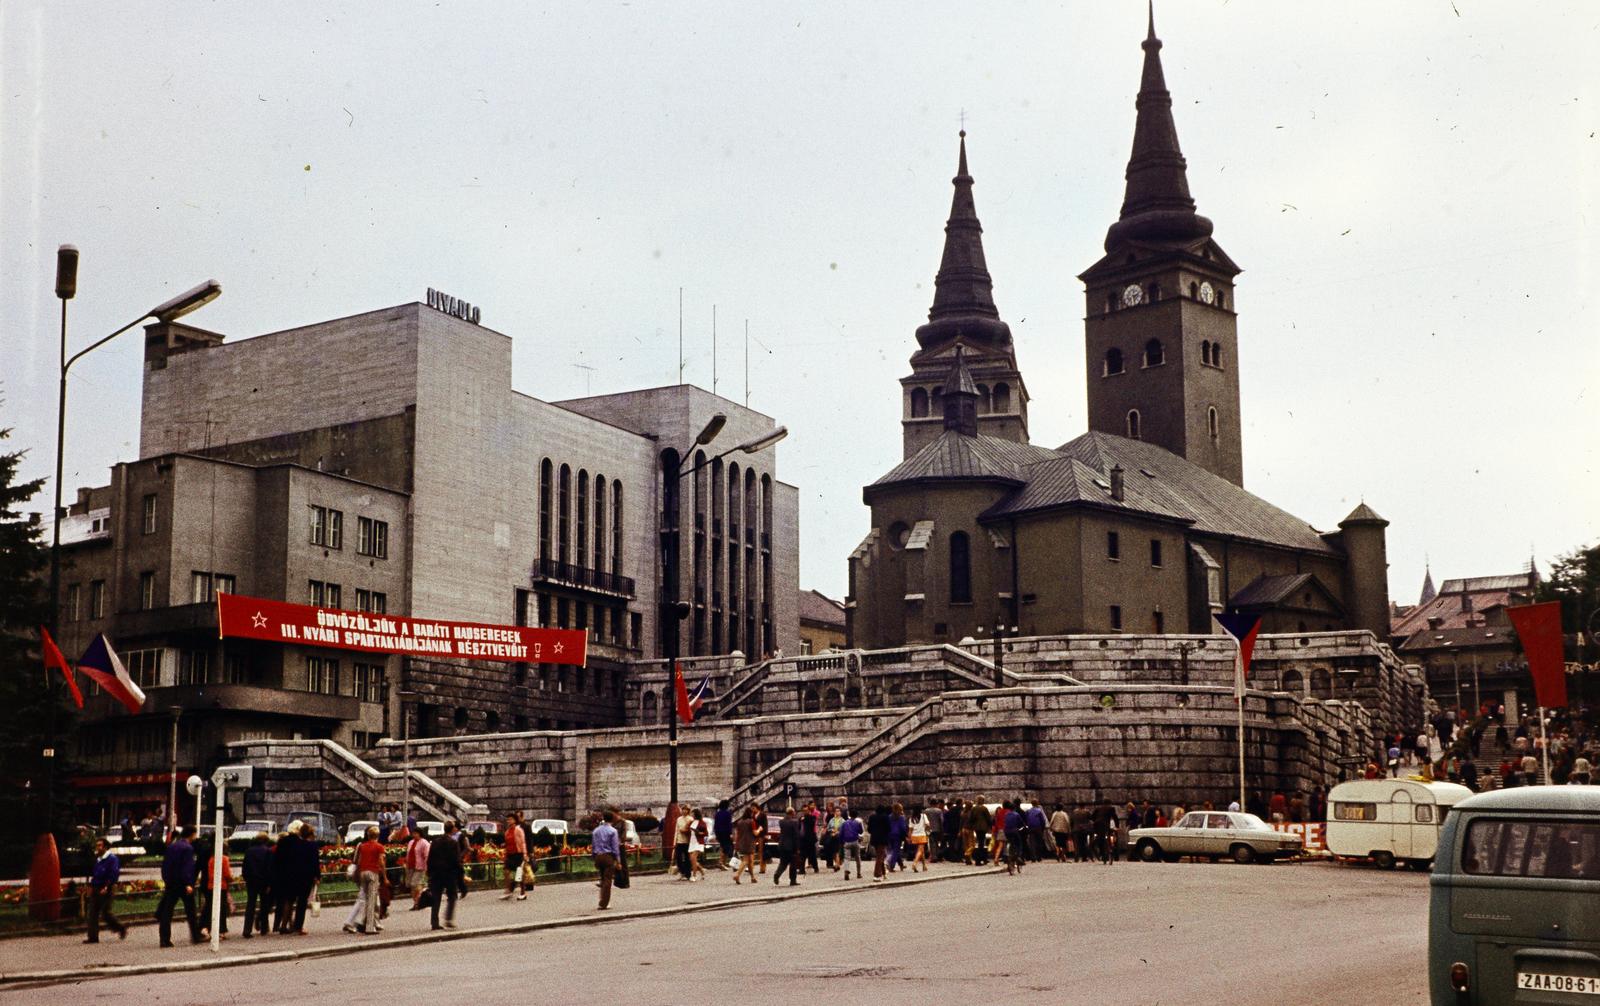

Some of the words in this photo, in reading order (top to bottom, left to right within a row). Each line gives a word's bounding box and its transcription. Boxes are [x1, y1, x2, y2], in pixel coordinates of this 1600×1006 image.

[427, 287, 481, 325] DIVADLO
[281, 623, 301, 639] III.
[303, 625, 339, 643] NYÁRI
[401, 622, 409, 635] A
[413, 622, 450, 638] BARÁTI
[786, 784, 794, 795] P
